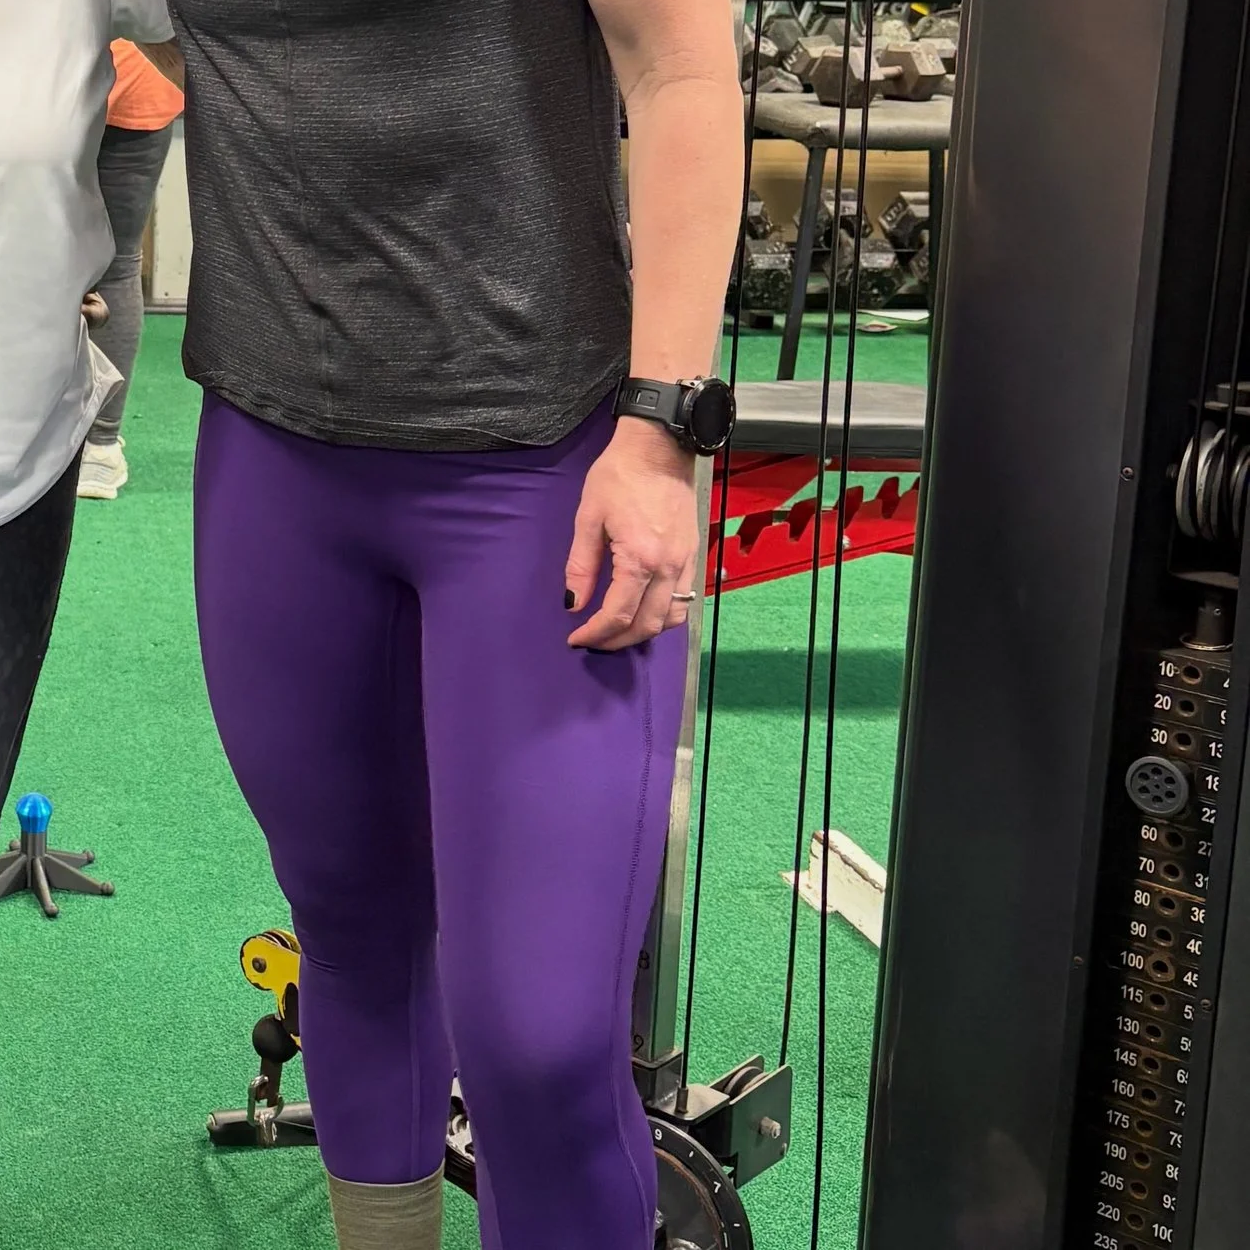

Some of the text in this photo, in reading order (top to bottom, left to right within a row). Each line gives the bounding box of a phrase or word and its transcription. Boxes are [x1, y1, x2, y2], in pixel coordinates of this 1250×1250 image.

[1159, 661, 1174, 677] 10
[1154, 694, 1171, 710] 20
[1151, 728, 1167, 744] 30
[1141, 825, 1157, 841] 60
[1139, 857, 1155, 873] 70
[1134, 890, 1150, 906] 80
[1130, 921, 1146, 938] 90
[639, 950, 649, 969] 8
[1120, 951, 1144, 969] 100
[1121, 985, 1143, 1003] 115
[1116, 1016, 1139, 1034] 130
[634, 1035, 644, 1052] 9
[1114, 1048, 1137, 1067] 145
[1112, 1079, 1135, 1097] 160
[1107, 1110, 1130, 1128] 175
[654, 1129, 662, 1140] 9
[1104, 1142, 1126, 1160] 190
[714, 1182, 721, 1193] 7
[1100, 1171, 1124, 1190] 205
[1097, 1202, 1120, 1221] 220
[1094, 1233, 1118, 1250] 235
